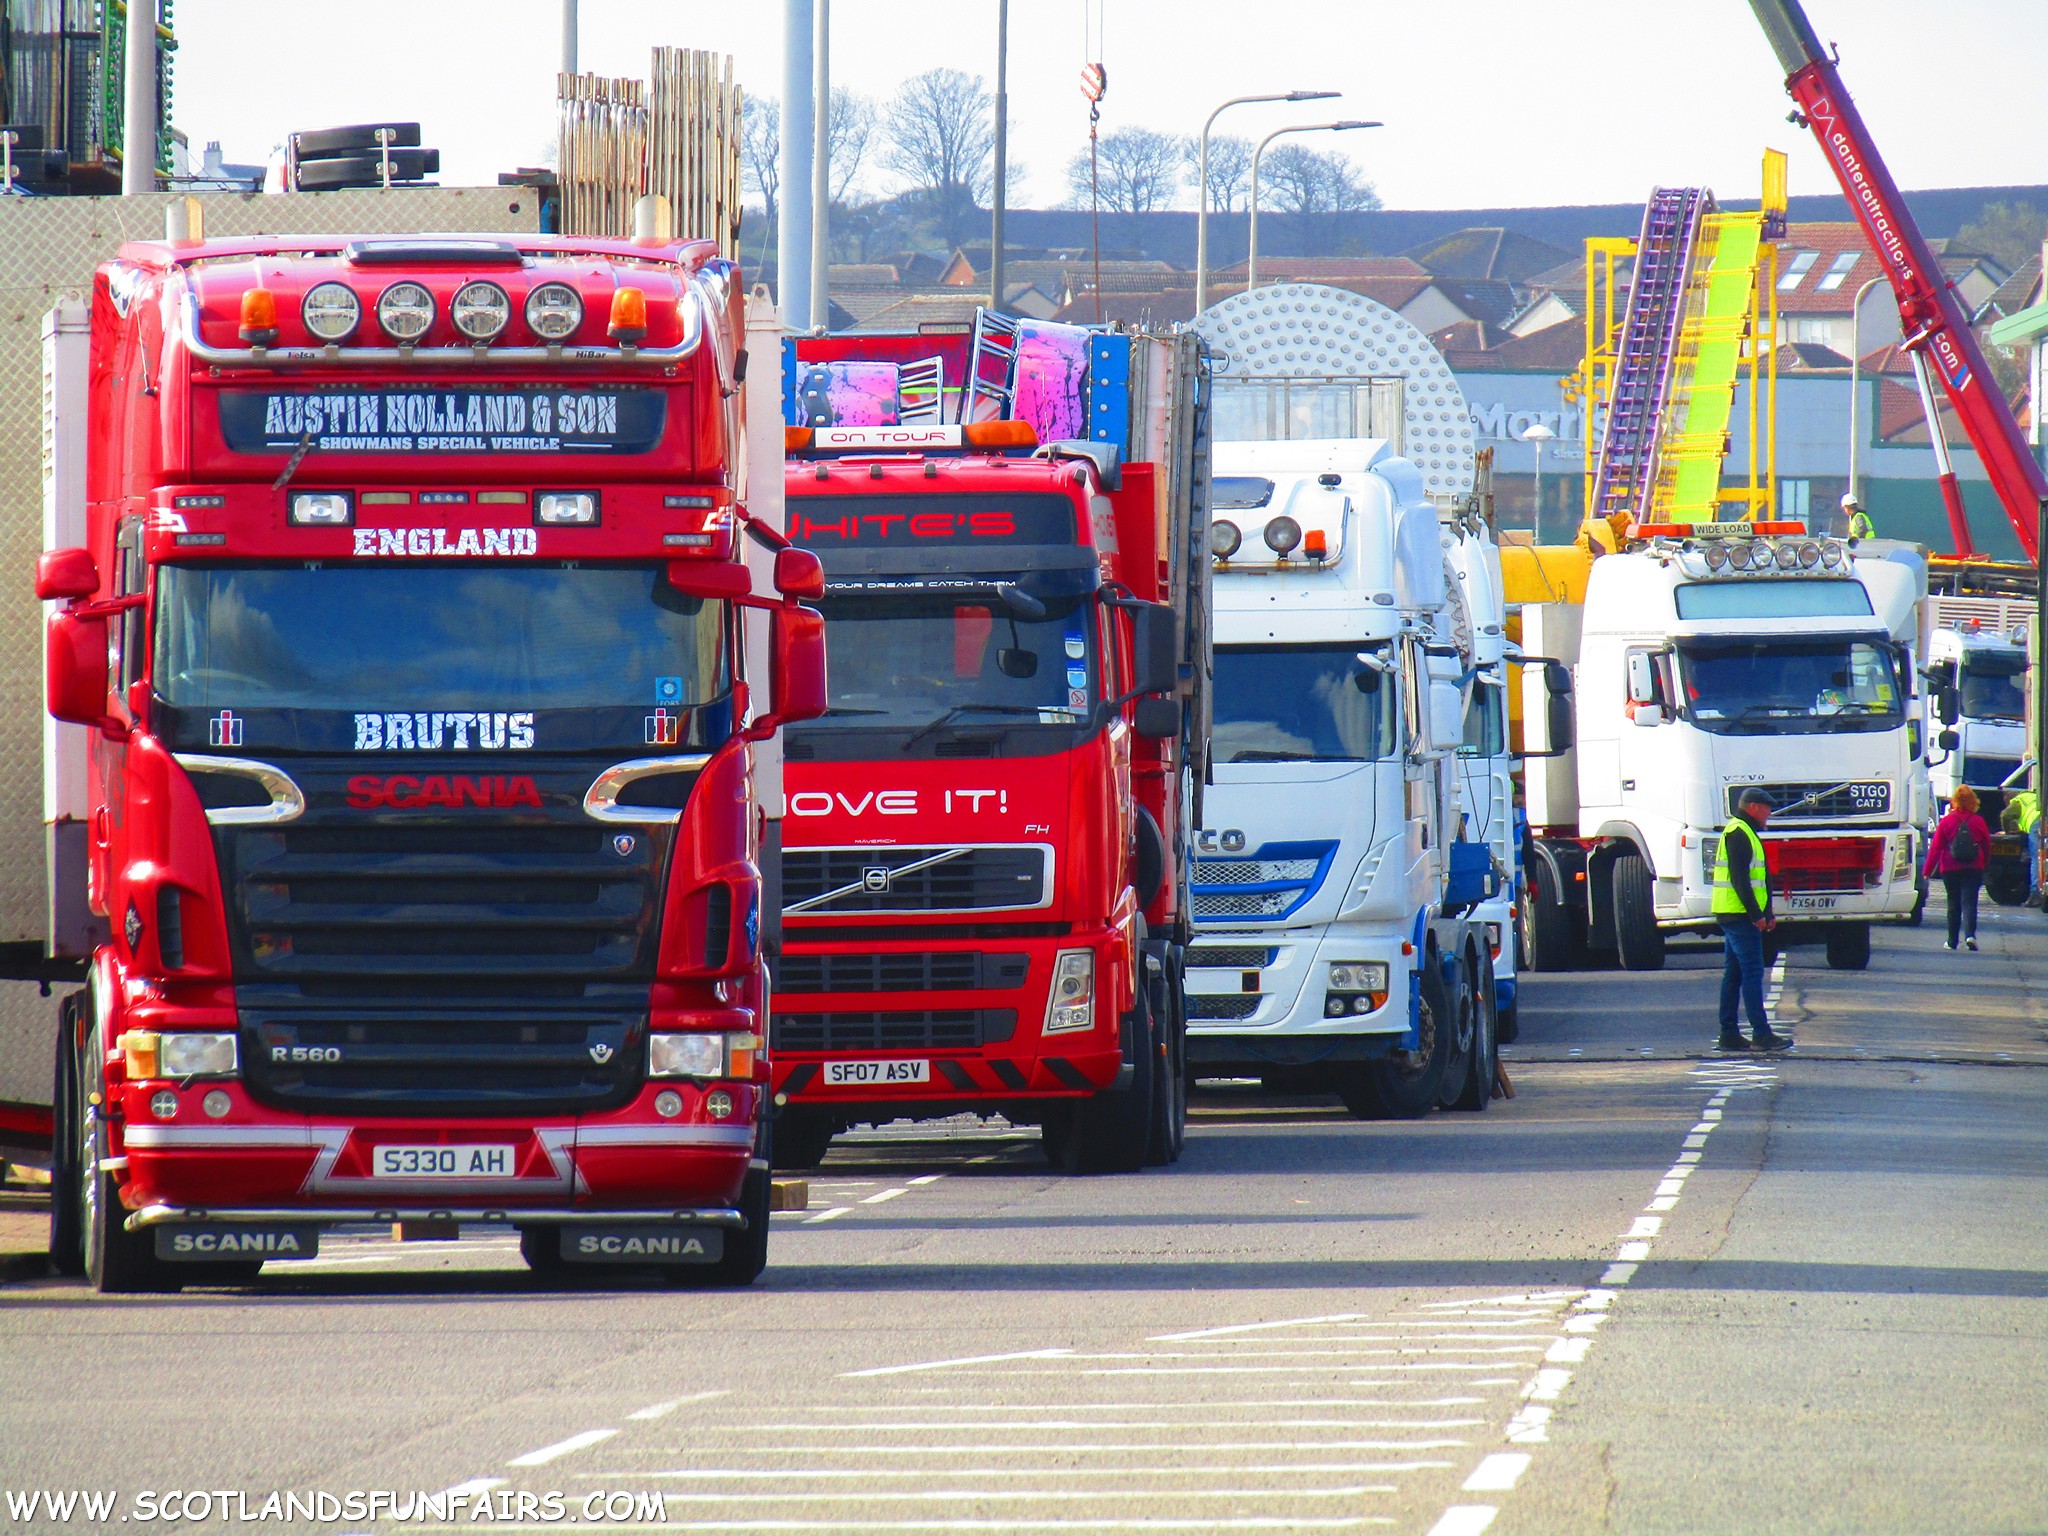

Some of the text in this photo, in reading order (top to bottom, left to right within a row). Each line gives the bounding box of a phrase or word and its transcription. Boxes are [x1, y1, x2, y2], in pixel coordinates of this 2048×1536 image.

[1833, 132, 1914, 281] danterattractios
[265, 394, 617, 434] AUSTIN HOLLAND & SON
[320, 436, 560, 450] SHOWMANS SPECIAL VEHICLE
[831, 432, 946, 442] ON TOUR
[785, 512, 1016, 540] HITE'S
[1696, 522, 1750, 534] WIDE LOAD
[353, 528, 537, 556] ENGLAND
[354, 712, 535, 750] BRUTUS
[345, 775, 543, 809] SCANIA
[1850, 784, 1887, 798] STGO
[782, 789, 1008, 816] OVE IT!
[1856, 798, 1882, 808] CAT 3
[1024, 824, 1050, 835] FH
[1791, 898, 1816, 908] FX54
[272, 1047, 341, 1063] R 560
[831, 1062, 921, 1081] SF07 ASV
[383, 1149, 505, 1173] S330 AH
[173, 1231, 300, 1252] SCANIA
[579, 1233, 704, 1255] SCANIA
